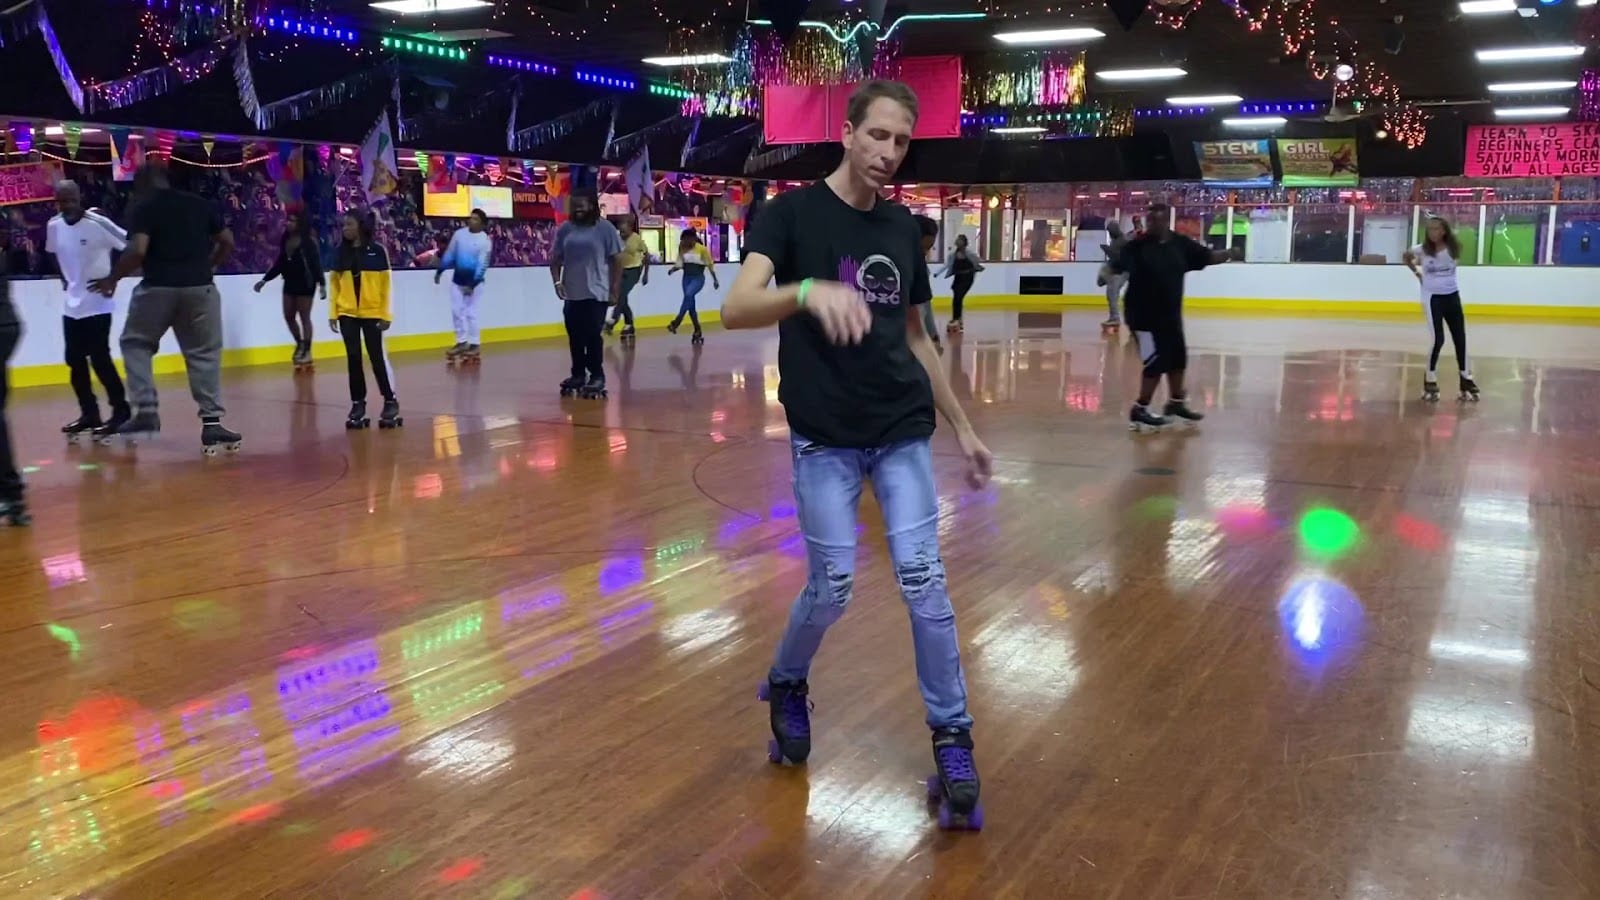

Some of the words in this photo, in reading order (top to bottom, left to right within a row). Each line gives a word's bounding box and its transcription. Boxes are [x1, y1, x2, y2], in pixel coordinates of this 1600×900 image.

[1481, 128, 1527, 139] LEARN
[1540, 126, 1557, 138] TO
[1203, 142, 1259, 155] STEM
[1283, 141, 1330, 154] GIRL
[1478, 139, 1563, 151] BEGINNERS
[1476, 151, 1550, 163] SATURDAY
[1482, 163, 1513, 176] 9AM
[1528, 162, 1553, 176] ALL
[1561, 161, 1600, 174] AGES
[513, 192, 537, 202] UNITED
